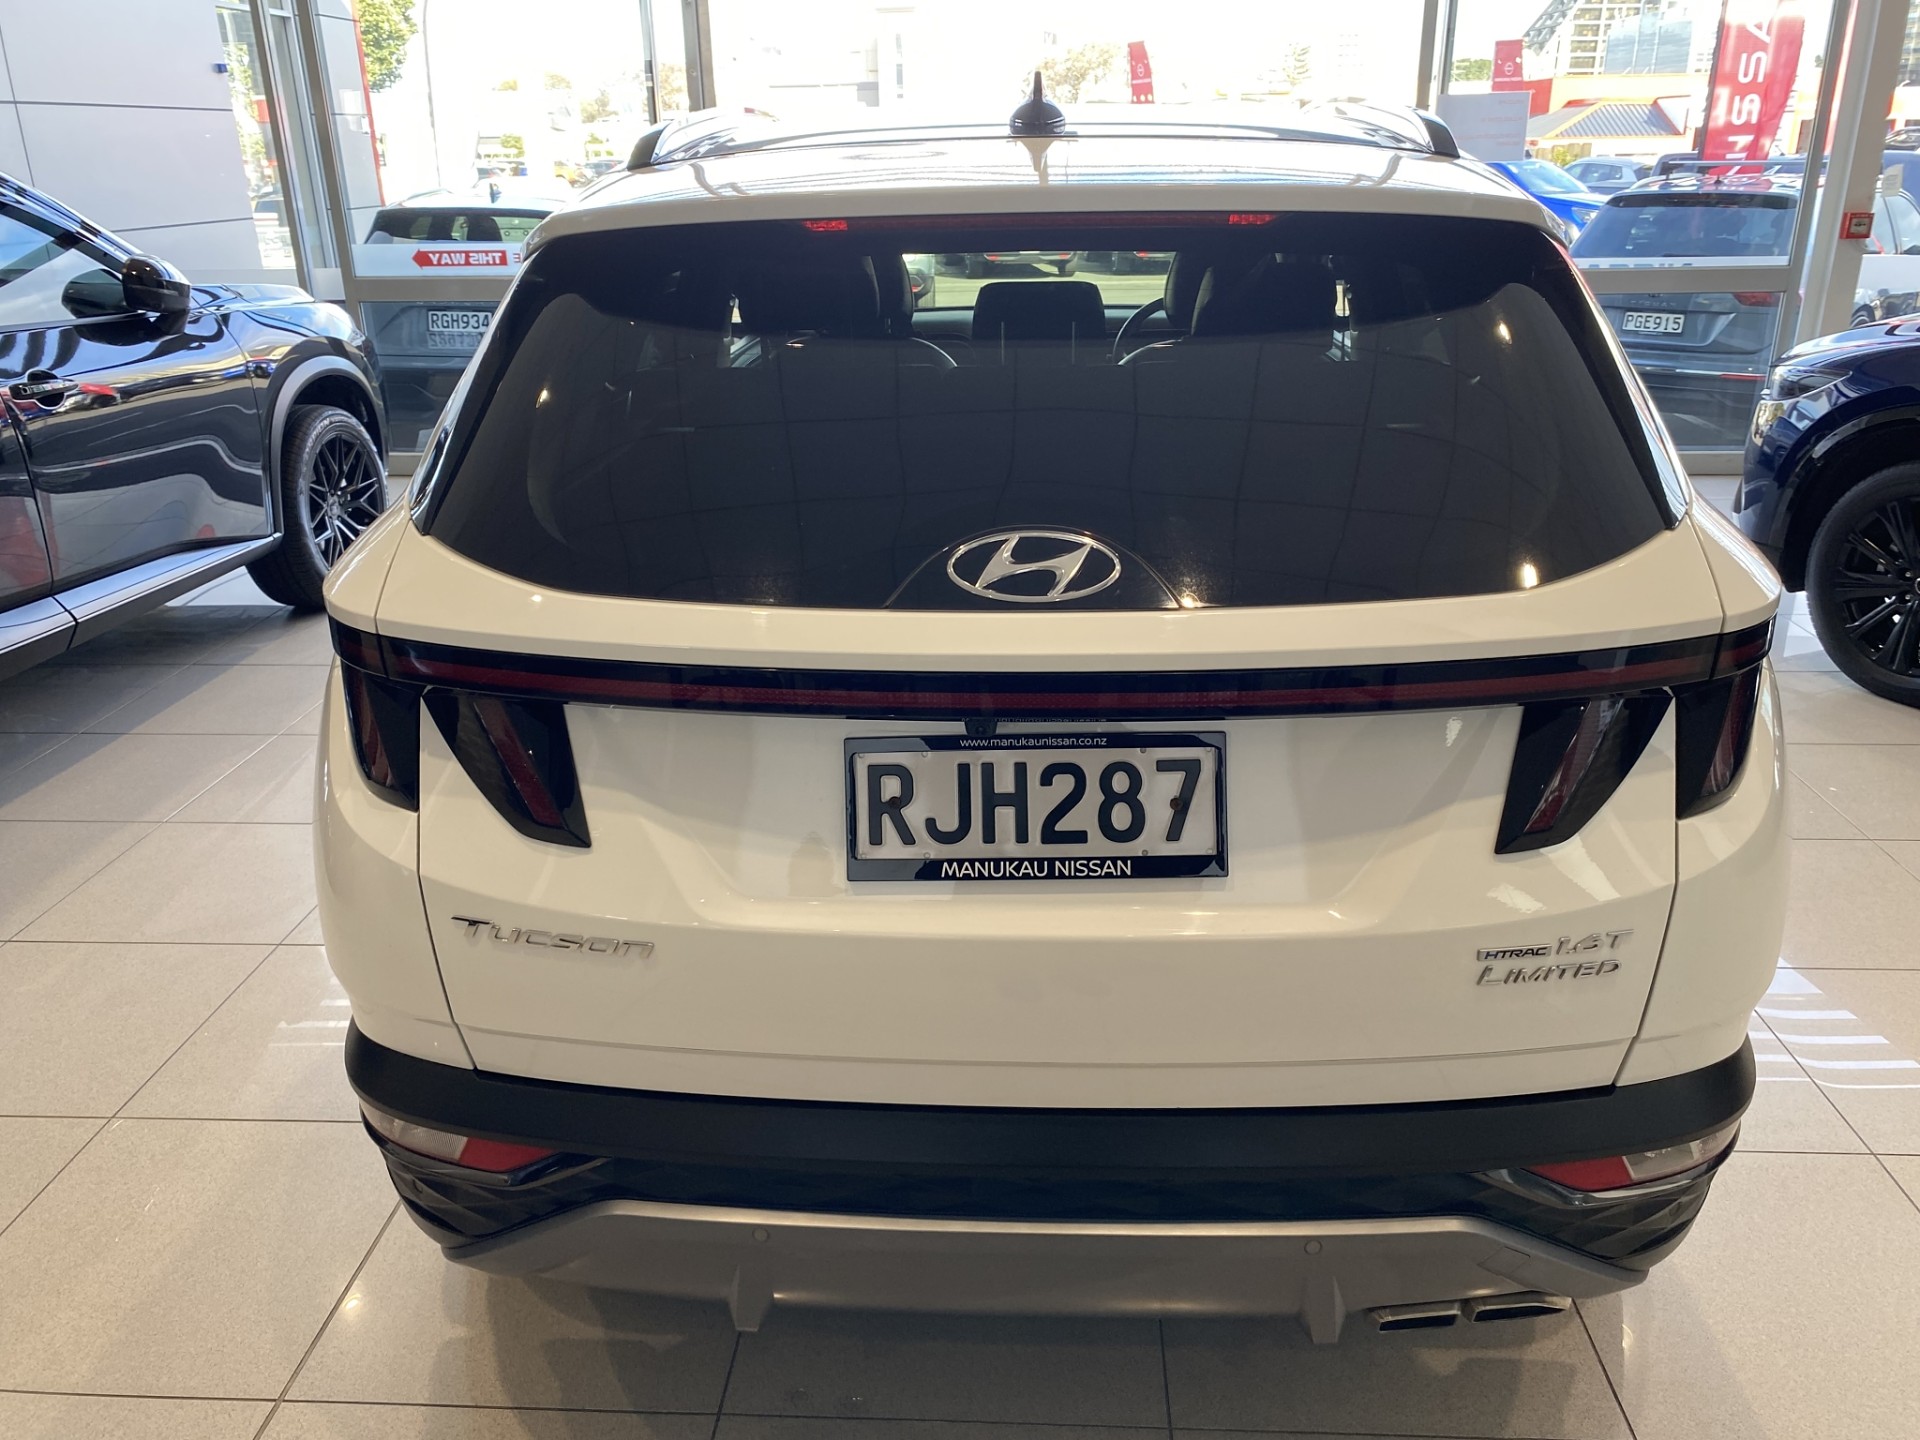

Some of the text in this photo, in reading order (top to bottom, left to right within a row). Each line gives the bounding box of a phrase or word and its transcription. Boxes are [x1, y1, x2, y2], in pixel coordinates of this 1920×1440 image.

[430, 313, 490, 330] RGH934
[1624, 314, 1682, 331] PGE915
[959, 736, 1108, 748] www.manukaunissan.co.nz
[867, 759, 1201, 846] RJH287
[940, 859, 1132, 879] MANUKAU NISSAN
[1483, 946, 1548, 960] HTRAC
[1476, 959, 1622, 986] LIMITED
